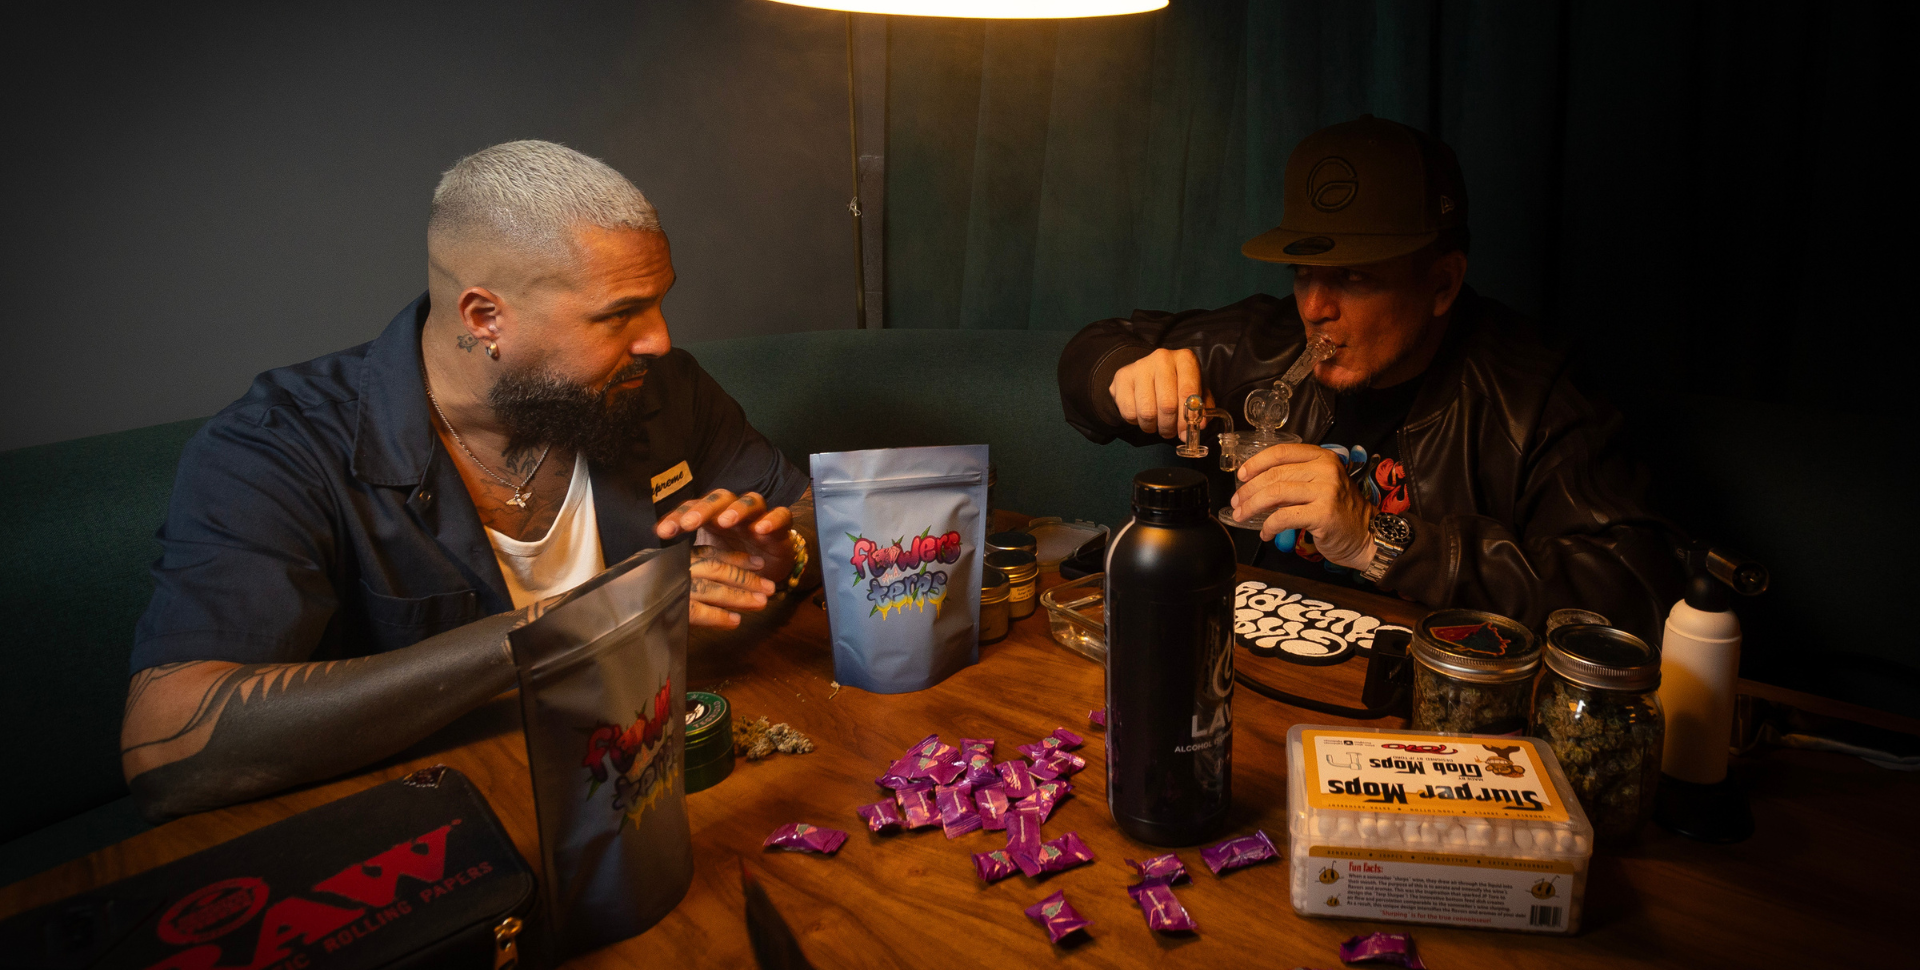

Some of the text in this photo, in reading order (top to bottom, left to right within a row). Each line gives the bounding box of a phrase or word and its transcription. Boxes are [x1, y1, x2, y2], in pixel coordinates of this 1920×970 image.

[1174, 740, 1213, 753] ALCOHOL
[1368, 756, 1482, 778] Glob Mops
[1327, 776, 1544, 811] Slurper Mops
[323, 860, 494, 954] ROLLING PAPERS
[1452, 915, 1491, 923] connoisseur!
